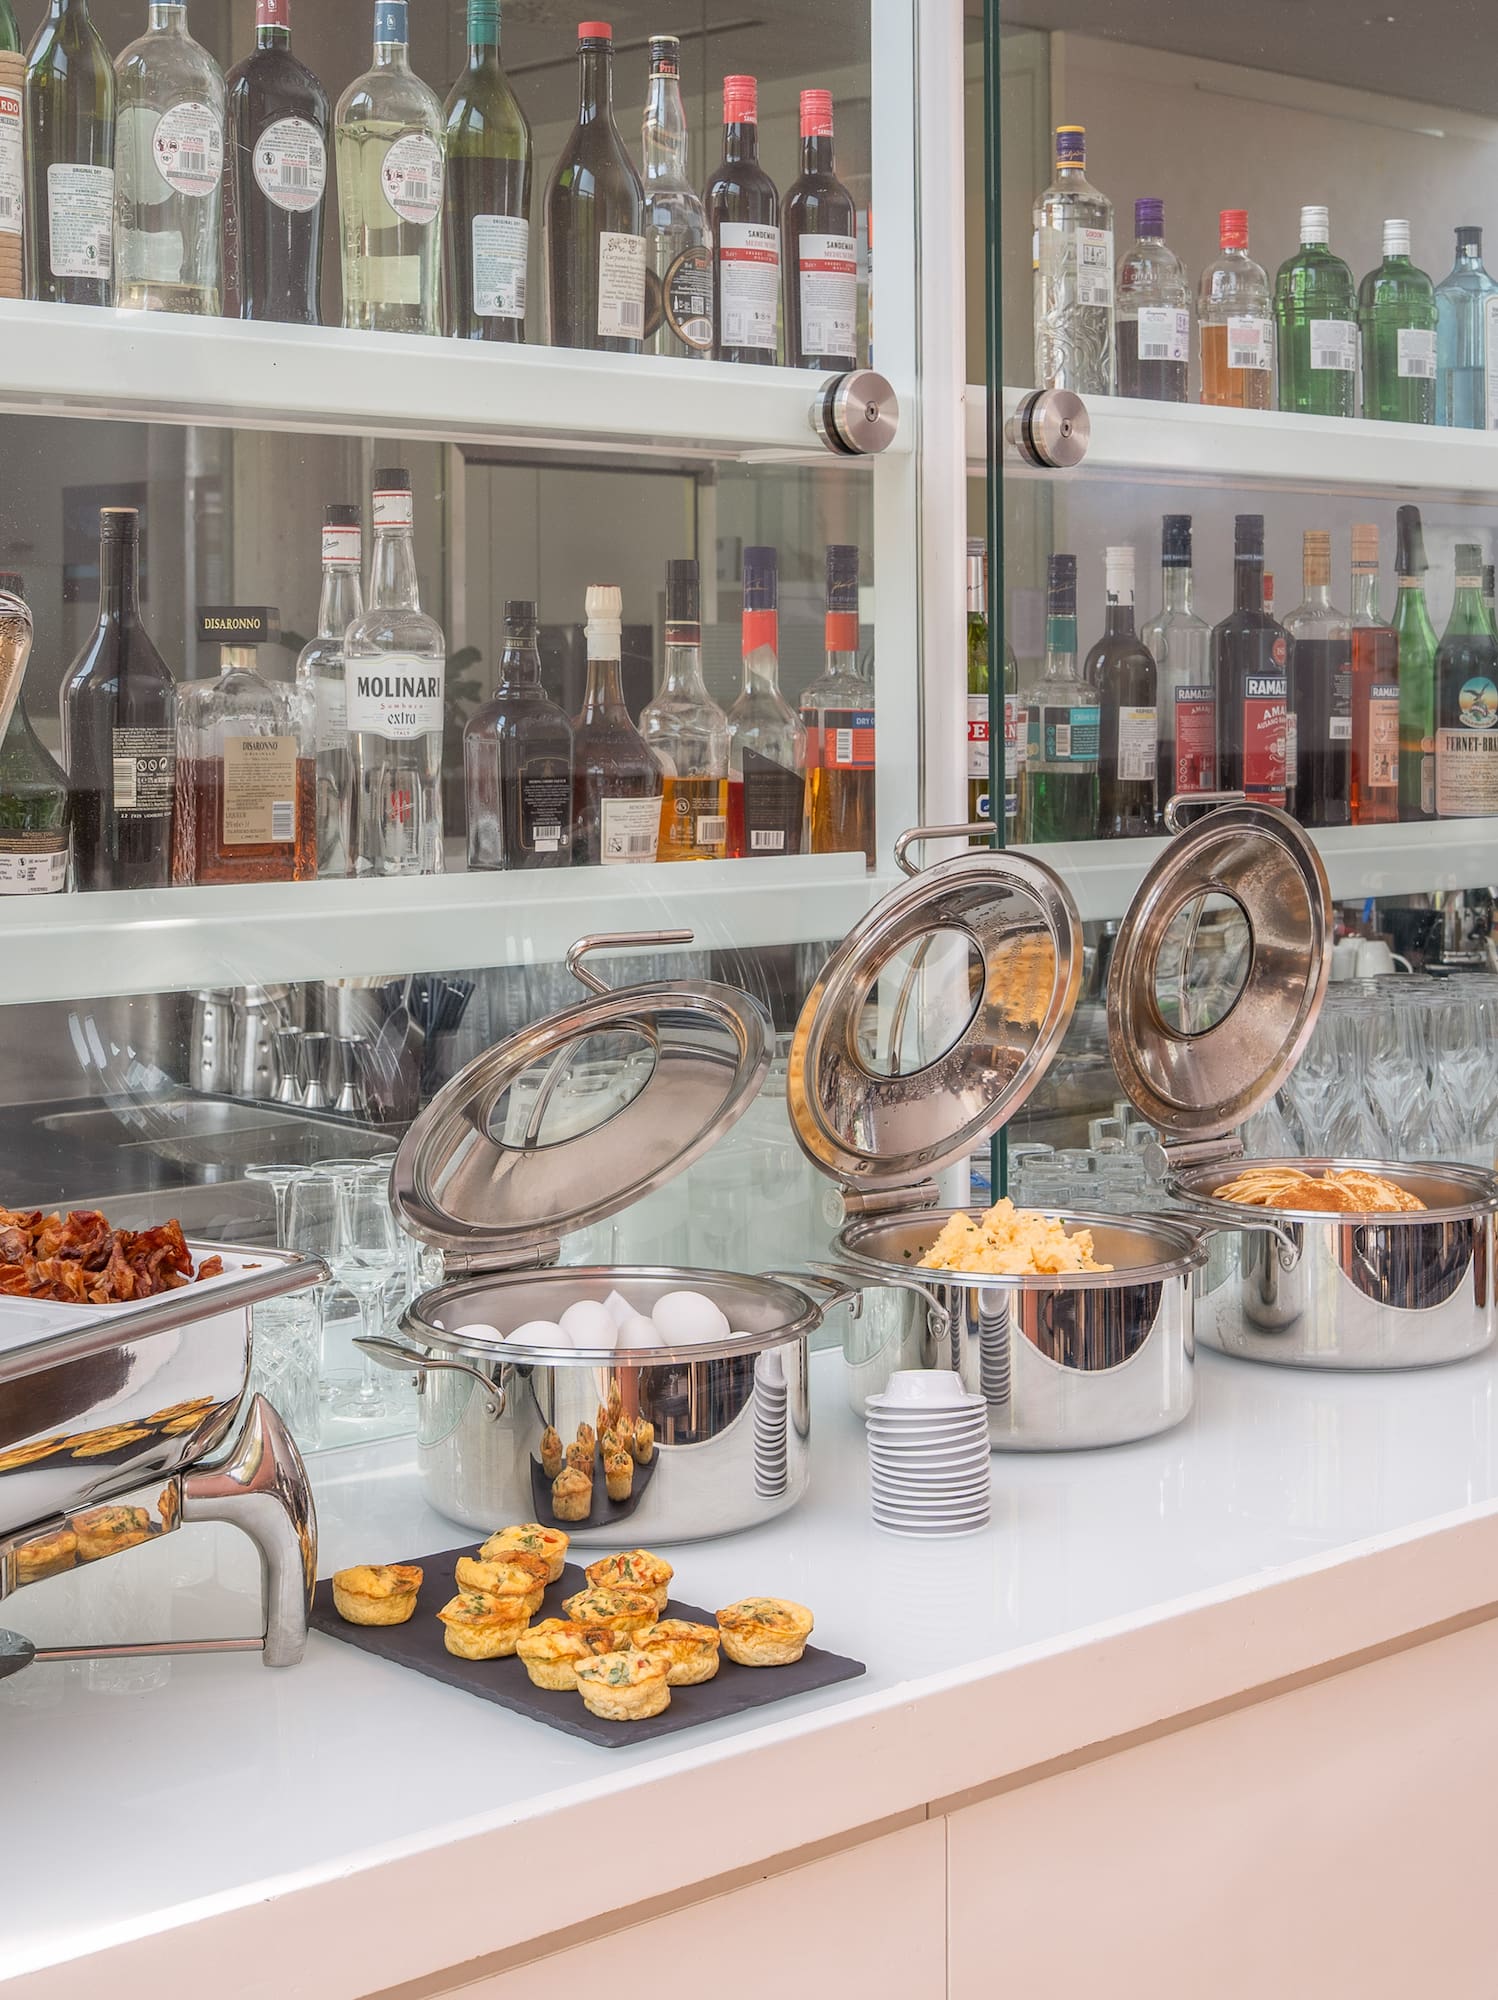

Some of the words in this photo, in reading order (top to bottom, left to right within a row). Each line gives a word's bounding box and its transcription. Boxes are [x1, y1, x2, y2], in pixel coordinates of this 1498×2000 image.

[204, 618, 261, 630] DISARONNO
[358, 676, 440, 698] MOLINARI
[387, 711, 416, 725] extra
[856, 717, 870, 726] DRY
[242, 741, 278, 751] DISARONNO
[1446, 736, 1498, 752] FERNET-BRA
